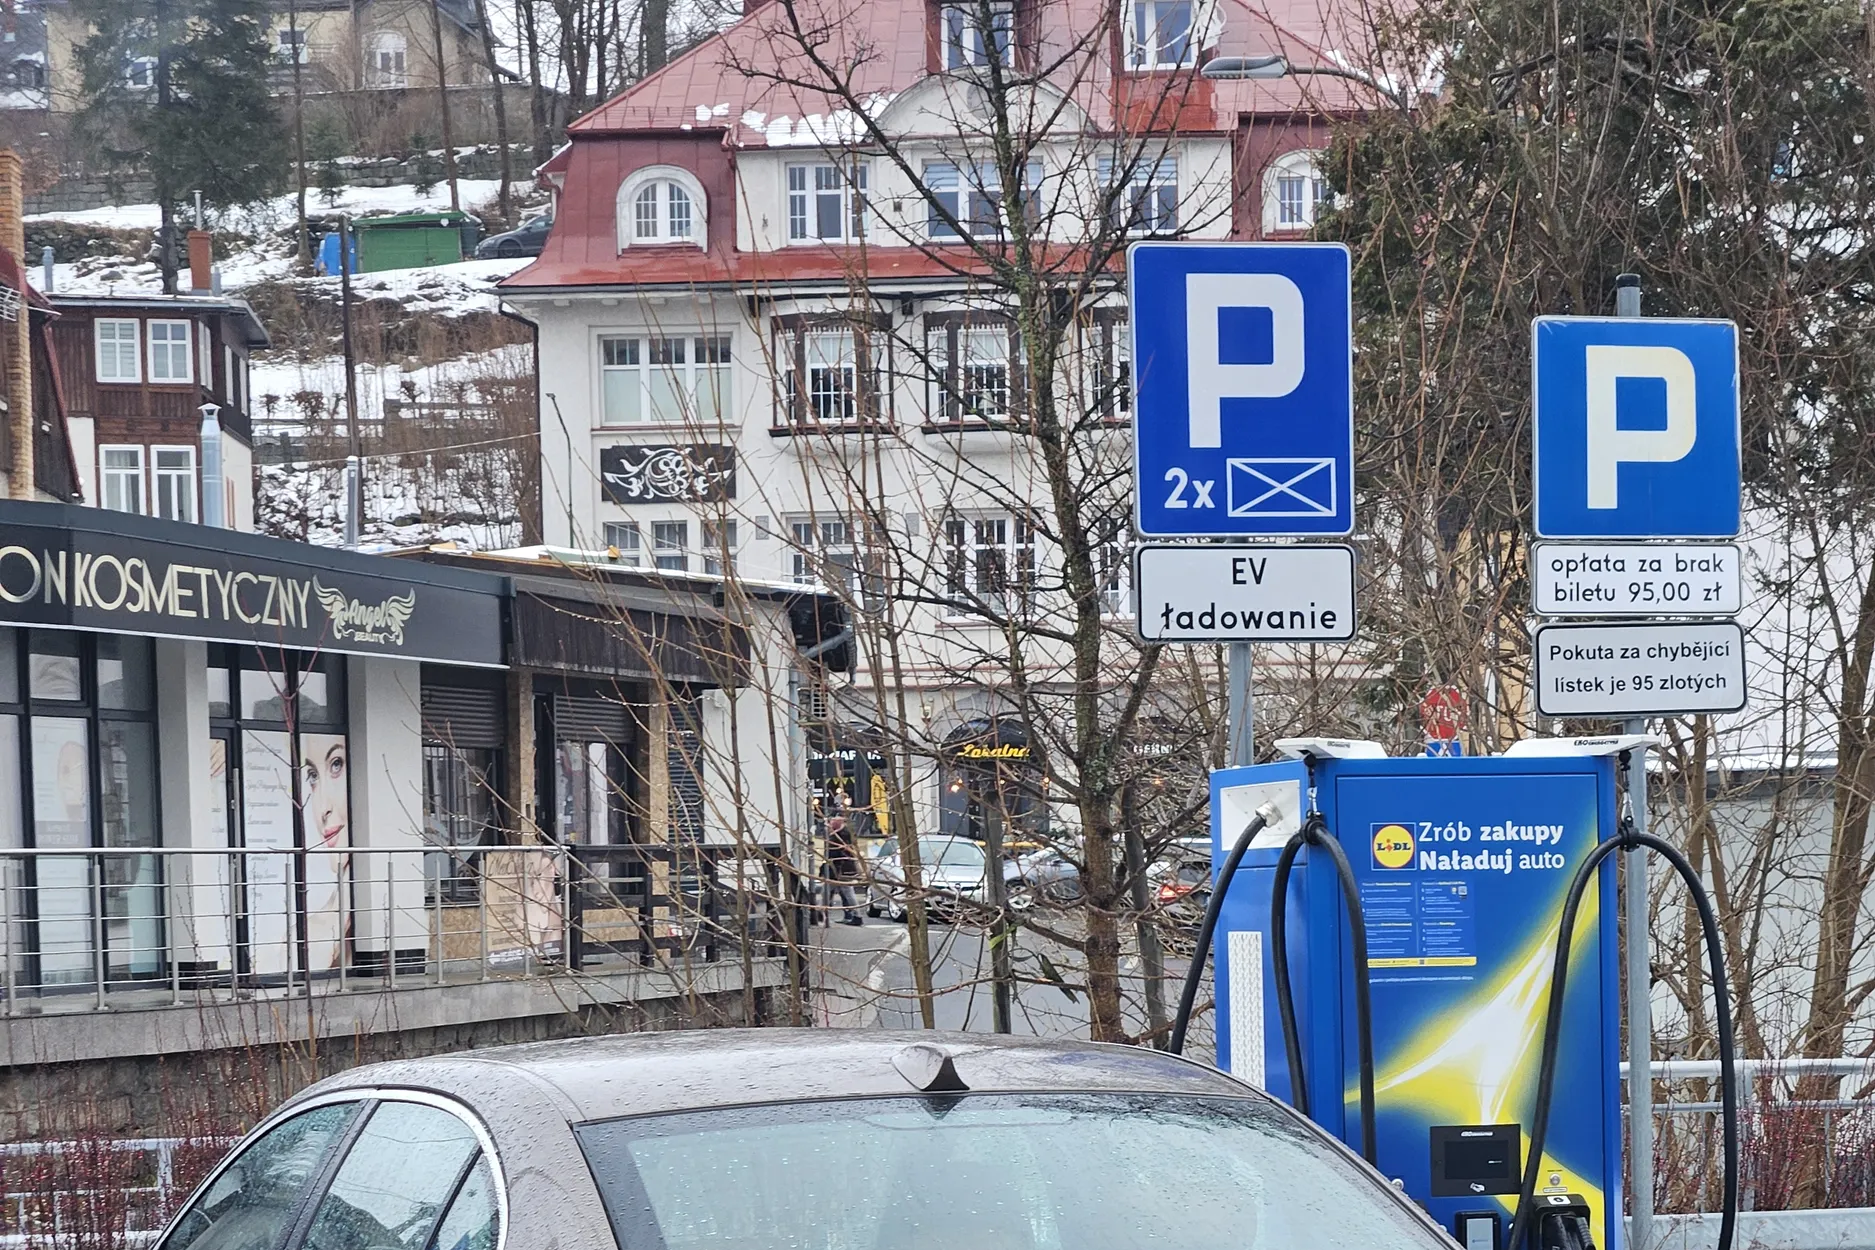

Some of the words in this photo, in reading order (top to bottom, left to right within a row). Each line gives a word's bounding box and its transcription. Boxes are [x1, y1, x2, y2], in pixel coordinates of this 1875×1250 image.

[1186, 272, 1306, 449] P
[1585, 344, 1697, 510] P
[1163, 466, 1216, 510] 2x
[1231, 556, 1268, 586] EV
[1550, 553, 1626, 579] opłata
[1637, 558, 1663, 573] za
[1674, 552, 1725, 573] brak
[74, 550, 311, 629] KOSMETYCZNY
[1554, 582, 1617, 603] biletu
[1627, 581, 1691, 605] 95,00
[1703, 580, 1723, 602] zł
[1160, 601, 1338, 631] ładowanie
[1549, 643, 1615, 662] Pokuta
[1619, 645, 1641, 660] za
[1645, 640, 1731, 662] chybějící
[1554, 675, 1605, 694] lístek
[1609, 677, 1626, 697] je
[1631, 675, 1655, 692] 95
[1658, 673, 1727, 695] zlotých
[1418, 821, 1472, 843] Zrób
[1479, 820, 1564, 846] zakupy
[1419, 848, 1513, 875] Naładuj
[1518, 852, 1566, 869] auto
